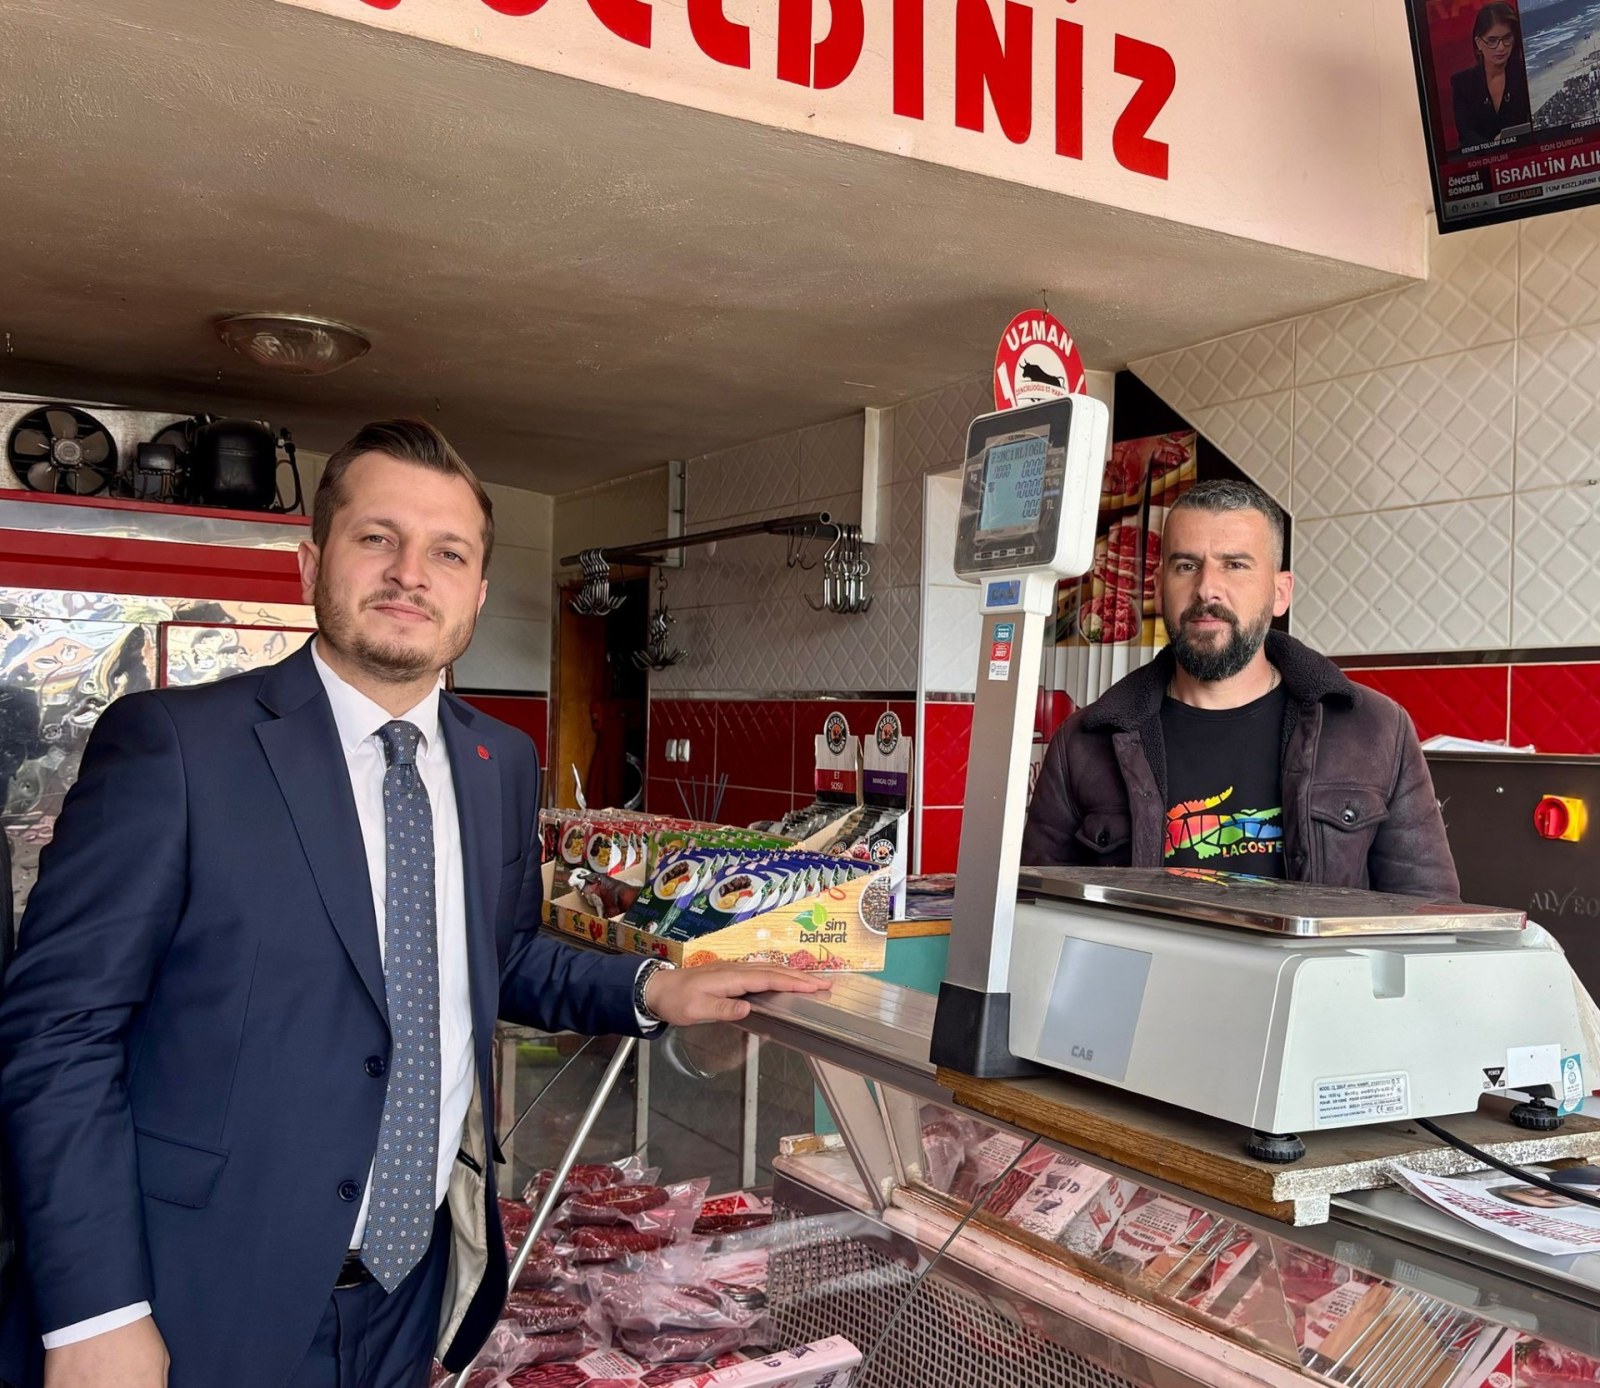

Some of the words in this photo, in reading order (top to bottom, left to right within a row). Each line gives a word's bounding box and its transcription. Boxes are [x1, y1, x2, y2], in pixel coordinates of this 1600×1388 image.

[1556, 136, 1584, 149] DURUM
[1482, 153, 1509, 166] DURUM
[1448, 170, 1480, 187] ÖNCESİ
[1495, 157, 1566, 186] İSRAİL'İN
[1448, 183, 1484, 197] SONRASI
[1005, 320, 1074, 358] UZMAN
[833, 771, 840, 780] ET
[830, 781, 844, 791] SOSU
[1222, 840, 1283, 858] LACOSTE
[825, 918, 847, 932] sim
[799, 930, 848, 944] baharat
[1071, 1045, 1094, 1061] CAS
